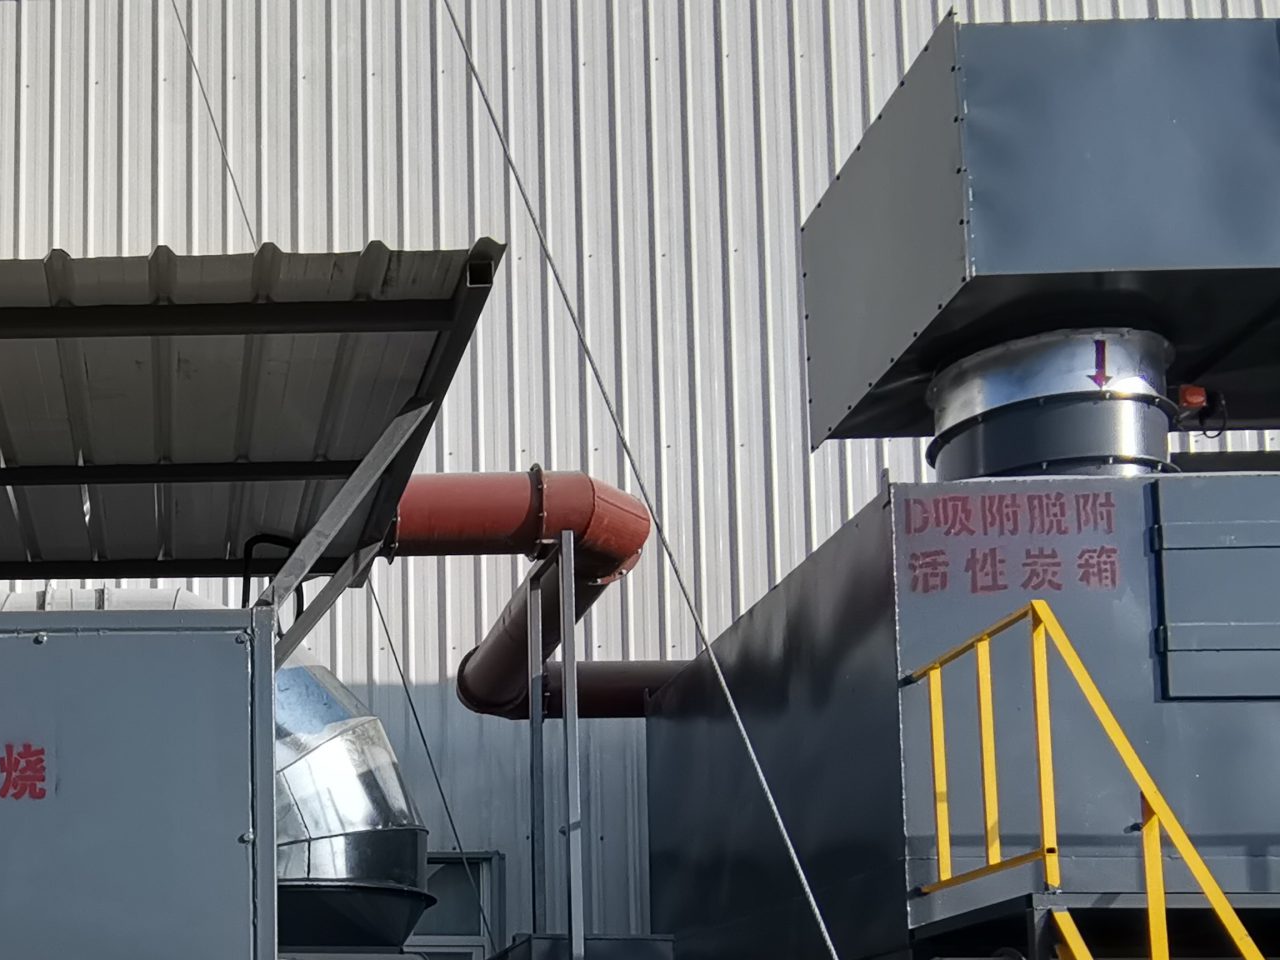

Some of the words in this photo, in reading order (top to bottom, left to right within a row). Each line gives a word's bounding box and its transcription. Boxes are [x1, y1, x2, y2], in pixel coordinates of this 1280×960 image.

[904, 492, 1115, 536] D吸附脱附
[908, 545, 1119, 594] 活性炭箱
